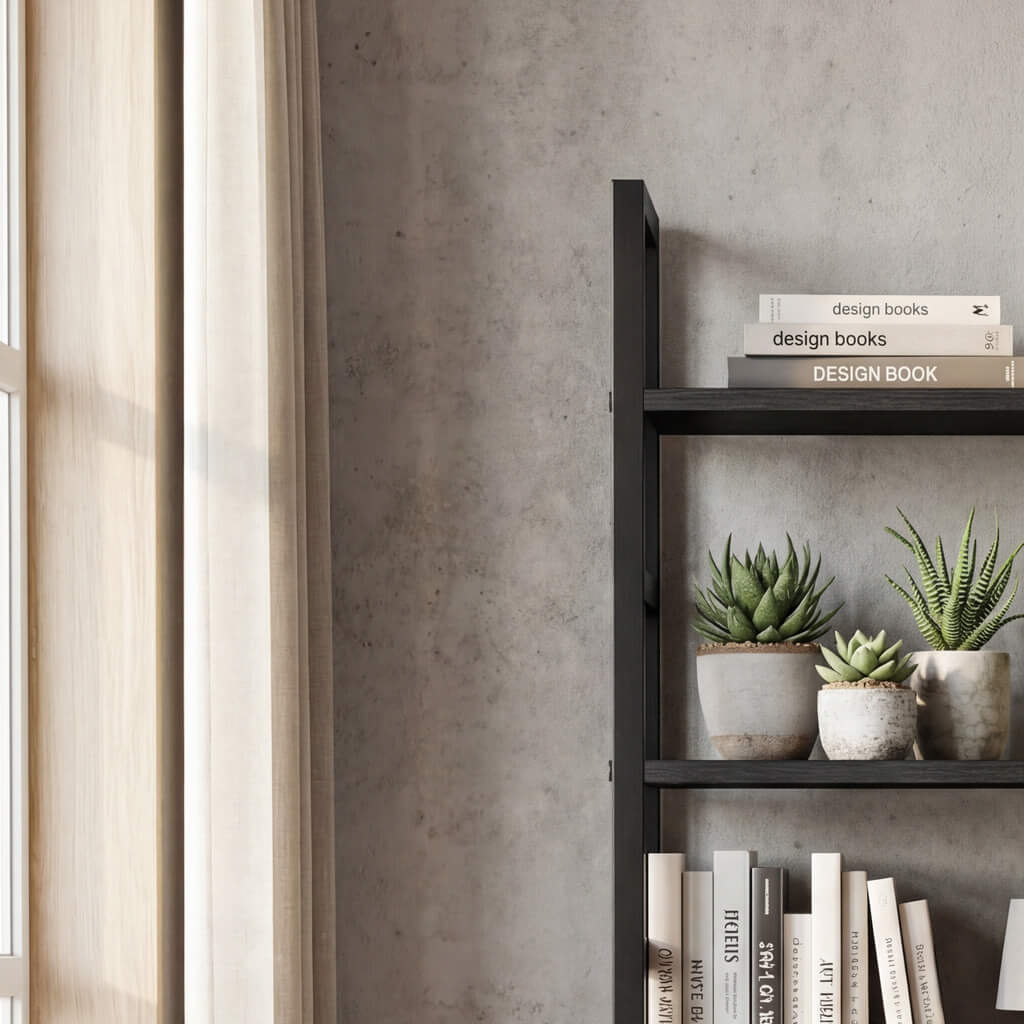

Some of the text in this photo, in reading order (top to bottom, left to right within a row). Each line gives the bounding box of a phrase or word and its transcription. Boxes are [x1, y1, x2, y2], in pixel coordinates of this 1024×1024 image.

[832, 302, 929, 318] design books
[773, 331, 887, 350] design books
[813, 366, 938, 382] DESIGN BOOK
